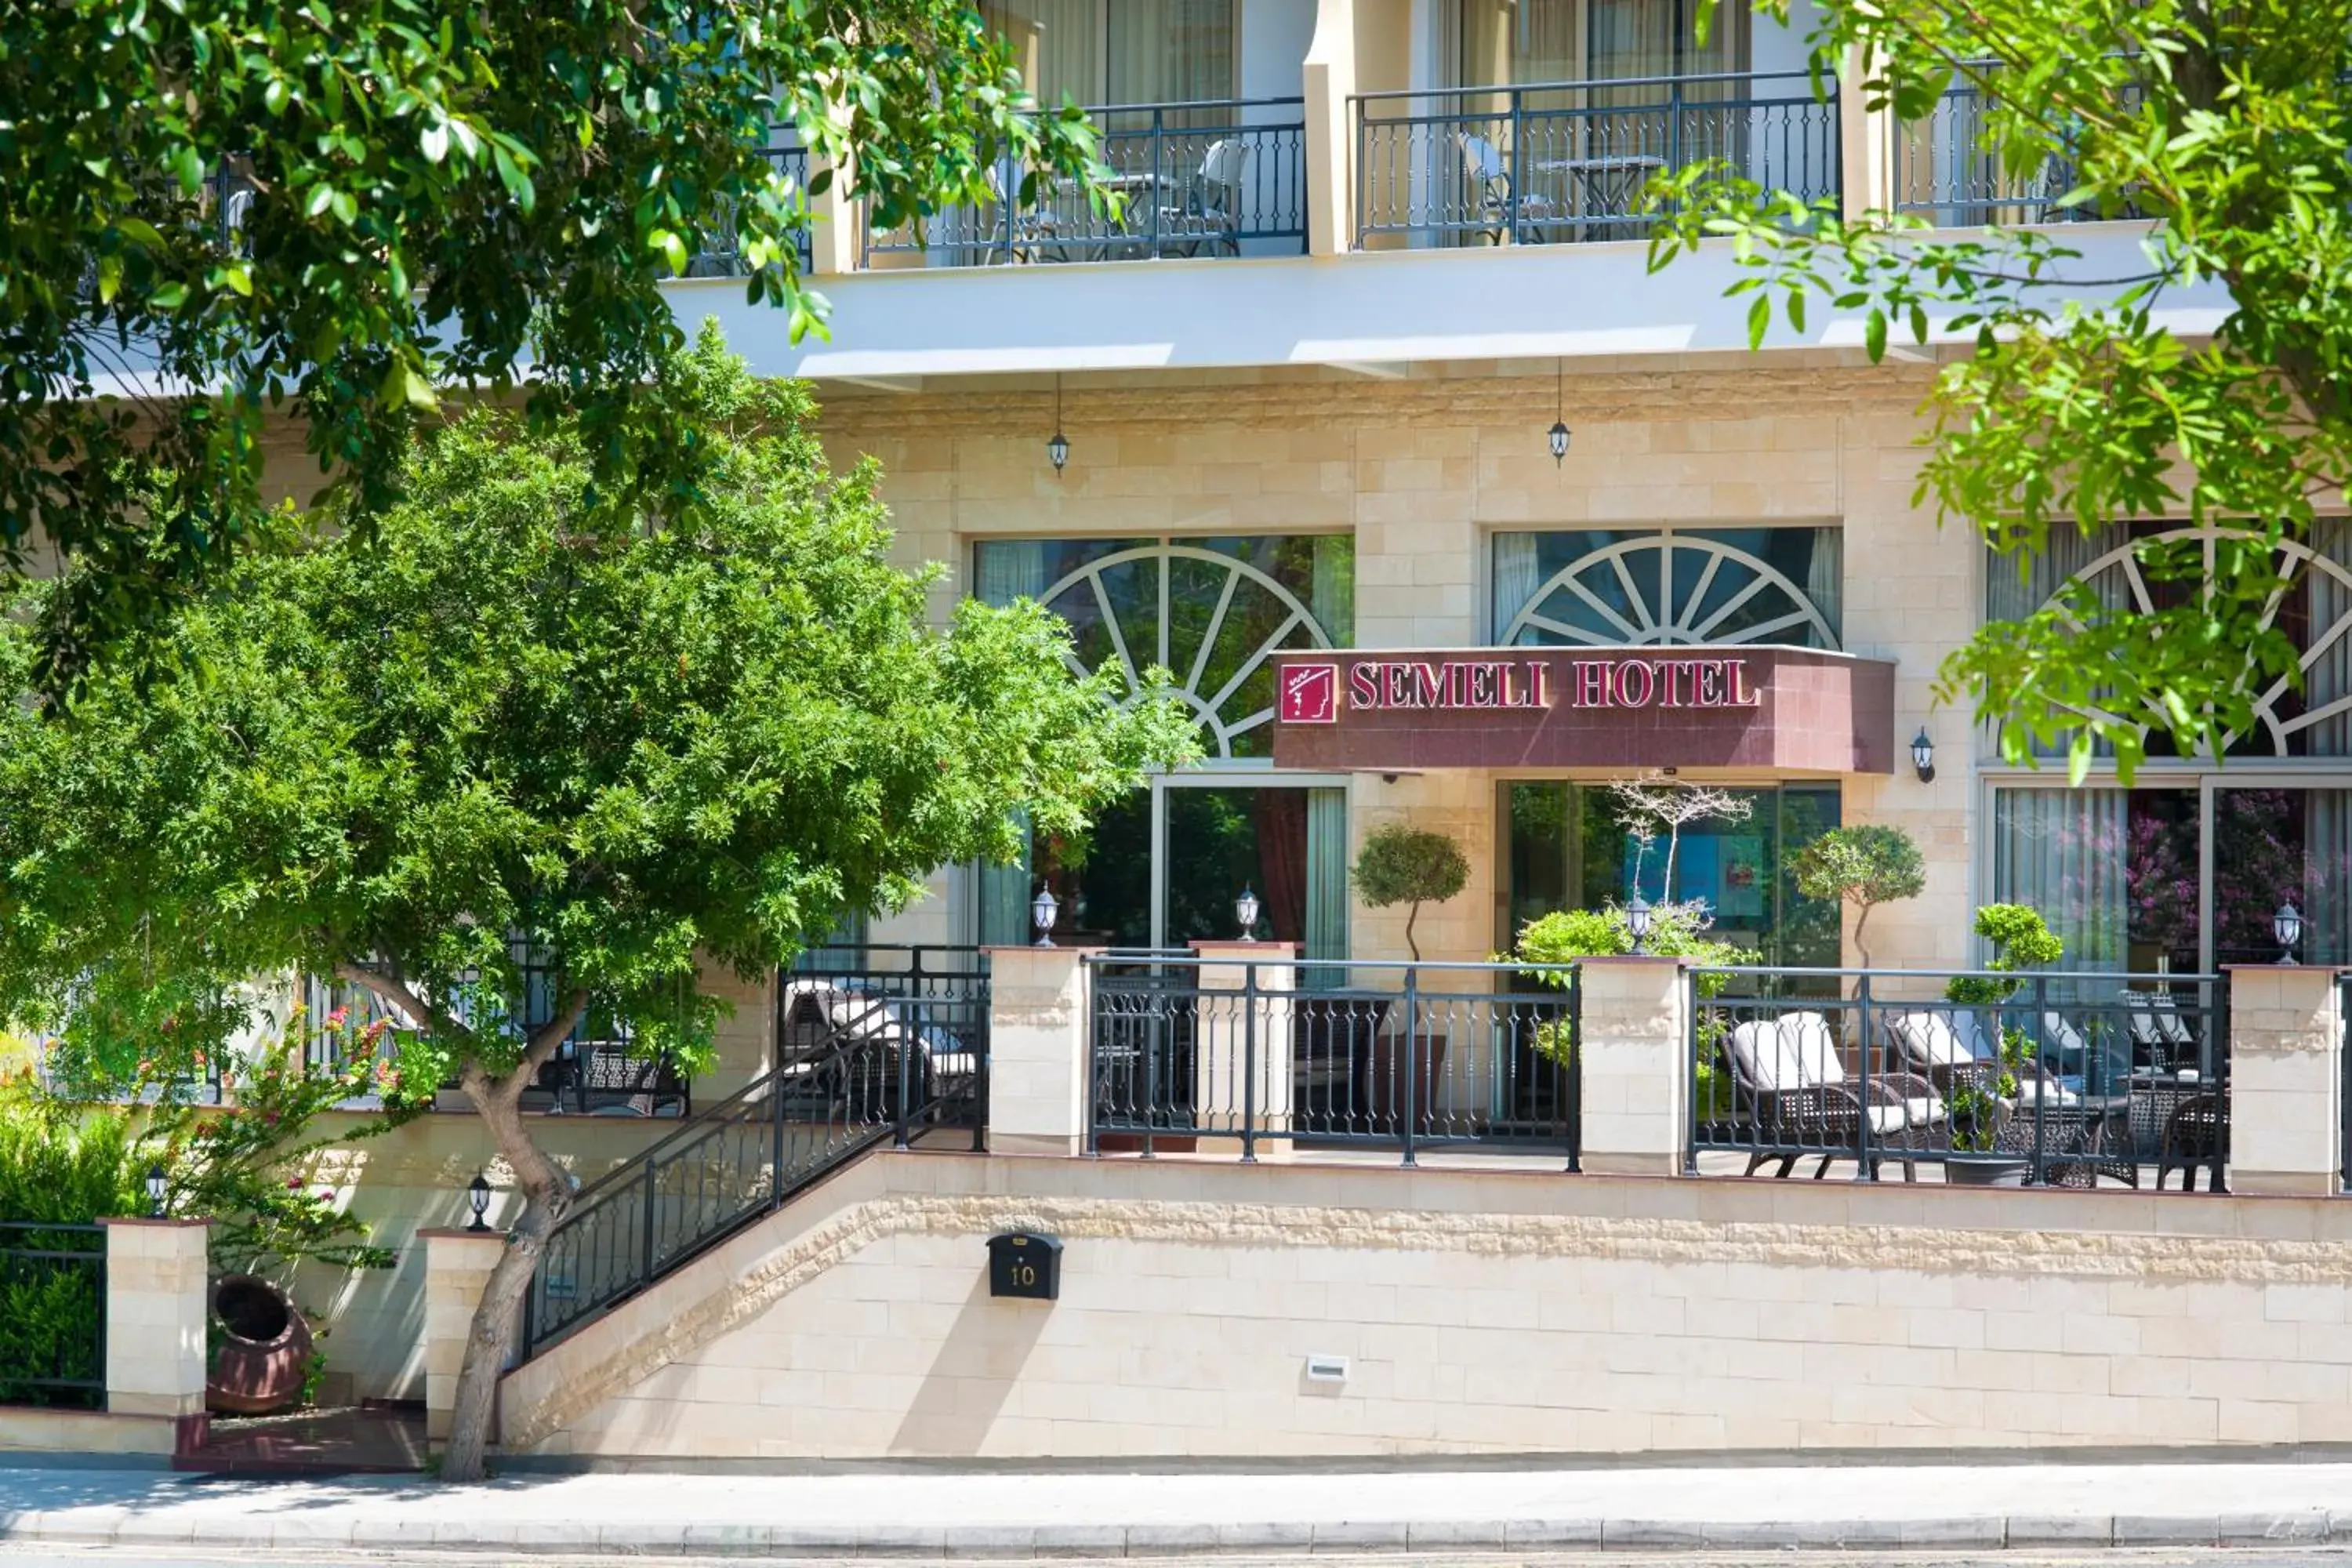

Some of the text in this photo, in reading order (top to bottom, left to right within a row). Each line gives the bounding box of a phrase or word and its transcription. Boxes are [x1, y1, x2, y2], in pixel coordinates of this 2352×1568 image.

[1350, 659, 1762, 709] SEMELI HOTEL
[1011, 1265, 1035, 1286] 10
